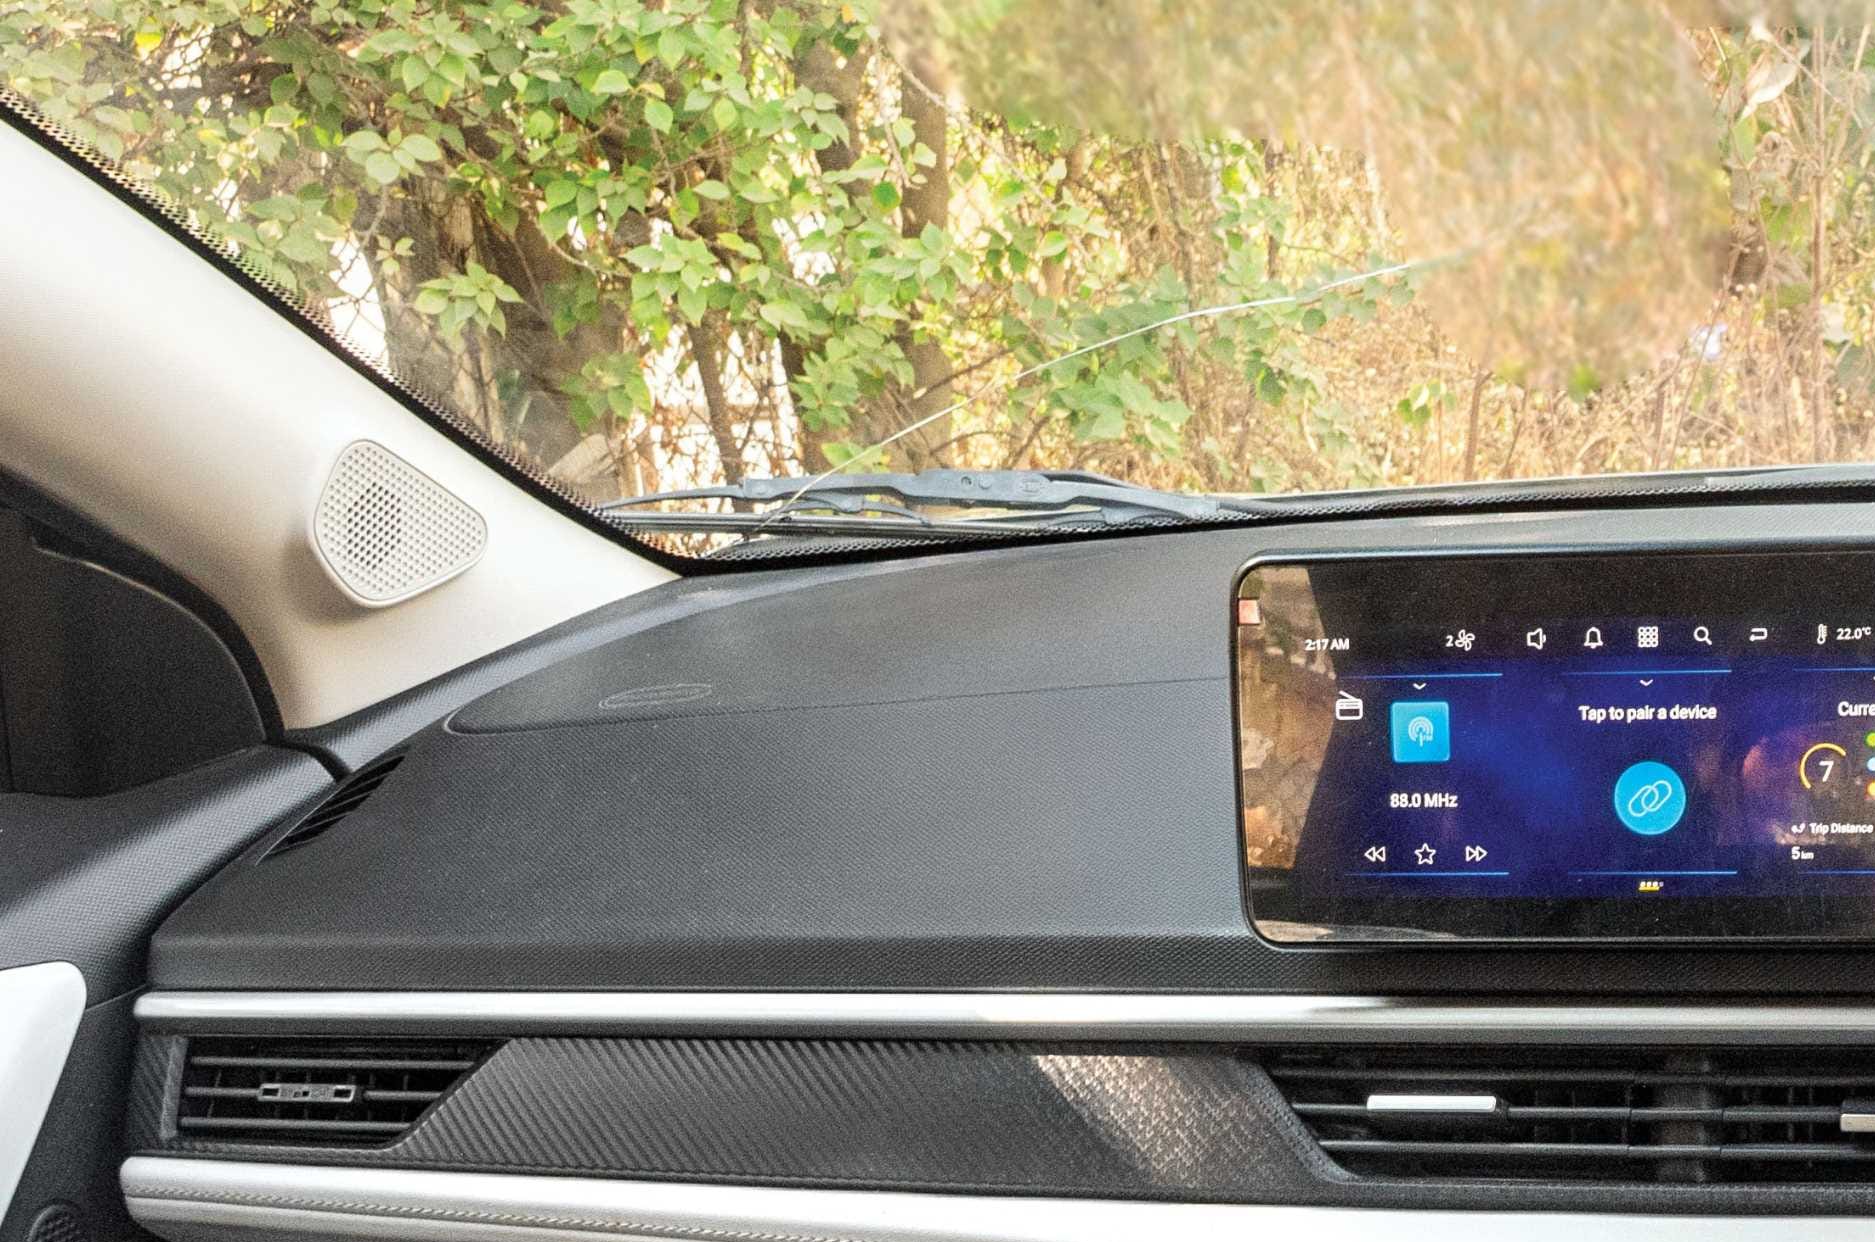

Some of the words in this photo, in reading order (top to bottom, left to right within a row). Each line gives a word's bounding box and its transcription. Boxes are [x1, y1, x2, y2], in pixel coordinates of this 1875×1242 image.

[1304, 639, 1329, 651] 2:17
[1330, 638, 1350, 650] AM
[1578, 705, 1606, 723] Tap
[1608, 706, 1625, 720] to
[1626, 705, 1655, 723] pair
[1657, 707, 1667, 720] a
[1669, 704, 1717, 720] device
[1818, 760, 1835, 782] 7
[1390, 793, 1422, 808] 88.0
[1424, 793, 1458, 808] MHz
[1808, 824, 1830, 835] Trip
[1830, 823, 1874, 834] Distance
[1791, 846, 1801, 860] 5
